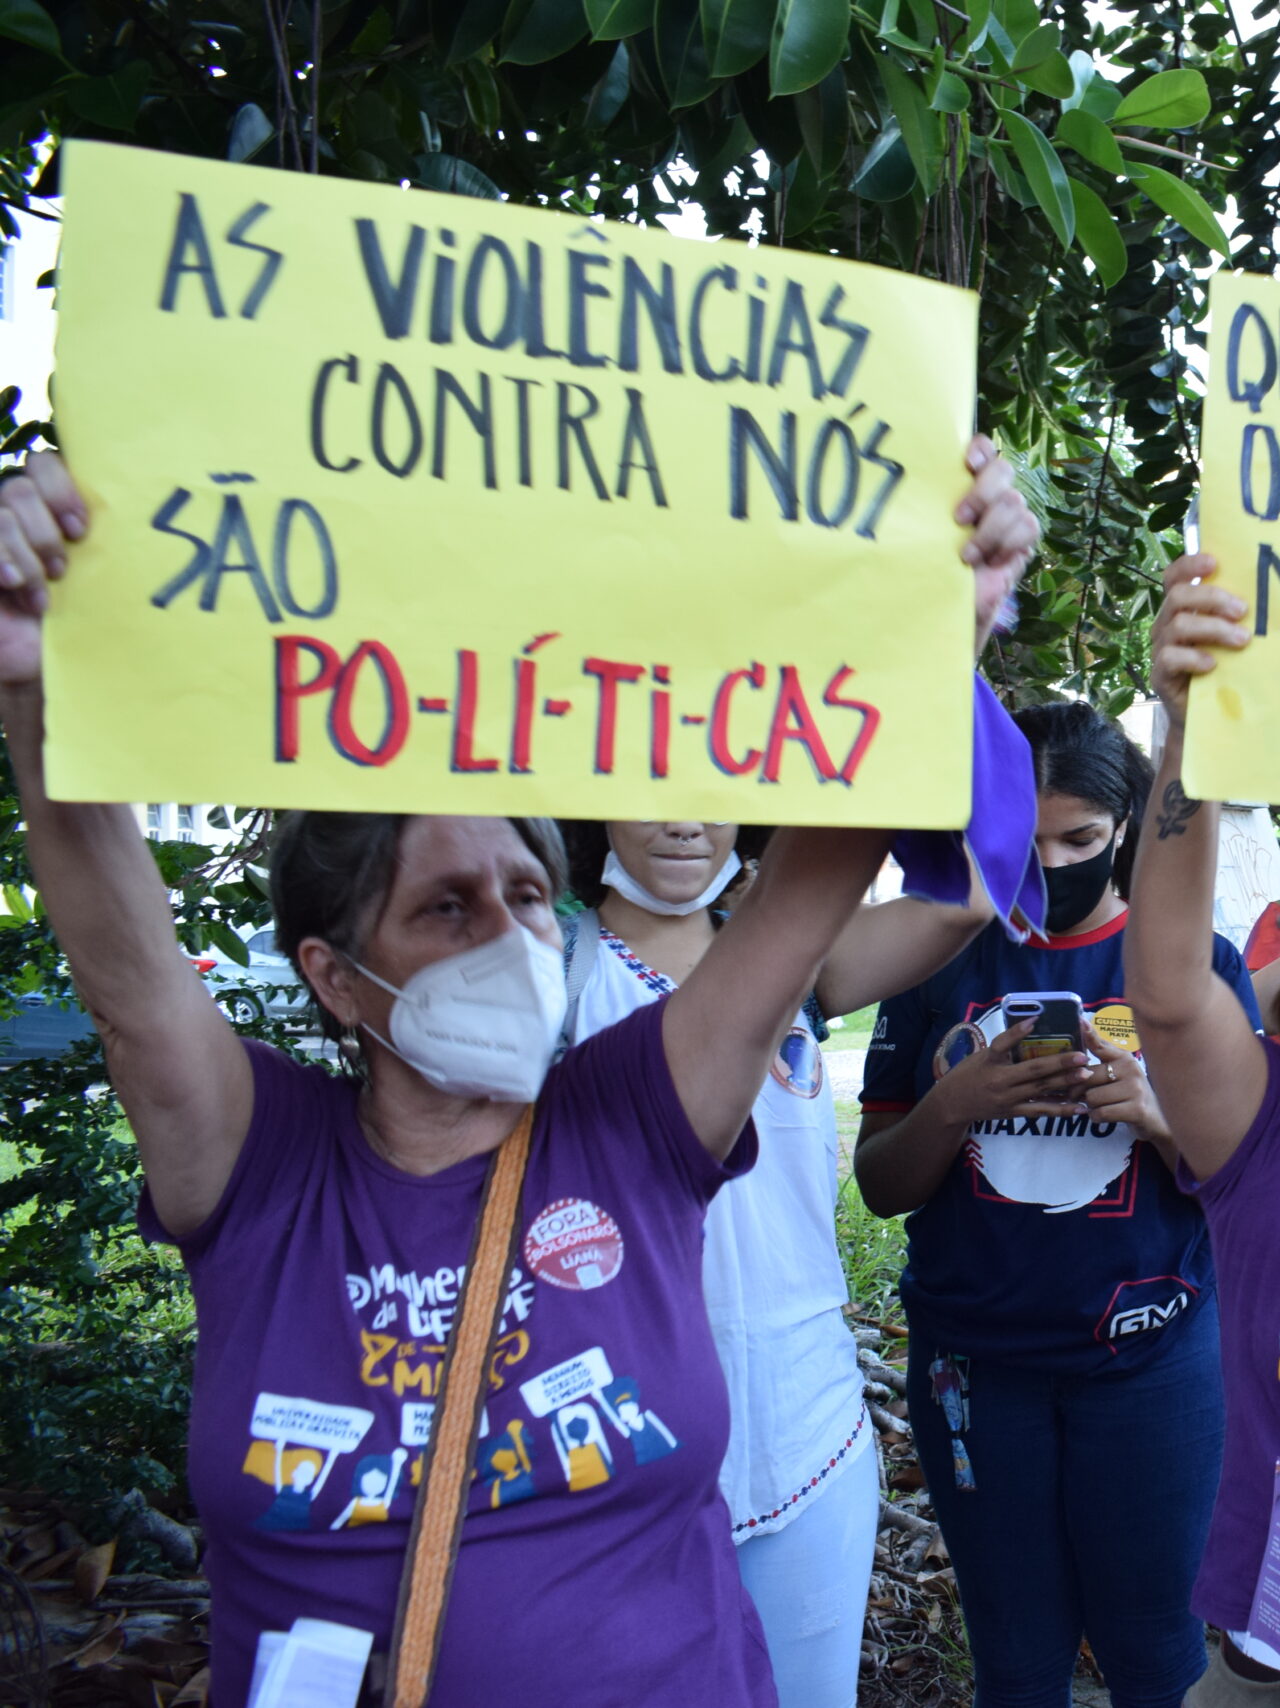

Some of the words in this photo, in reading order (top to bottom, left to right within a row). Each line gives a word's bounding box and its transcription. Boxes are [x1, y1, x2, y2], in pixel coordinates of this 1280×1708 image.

[159, 192, 284, 319] AS
[311, 355, 668, 507] CONTRA
[730, 403, 905, 540] NÓS
[151, 472, 338, 622] SÃO
[1096, 1018, 1134, 1027] CUIDAD
[537, 1208, 594, 1239] FORA
